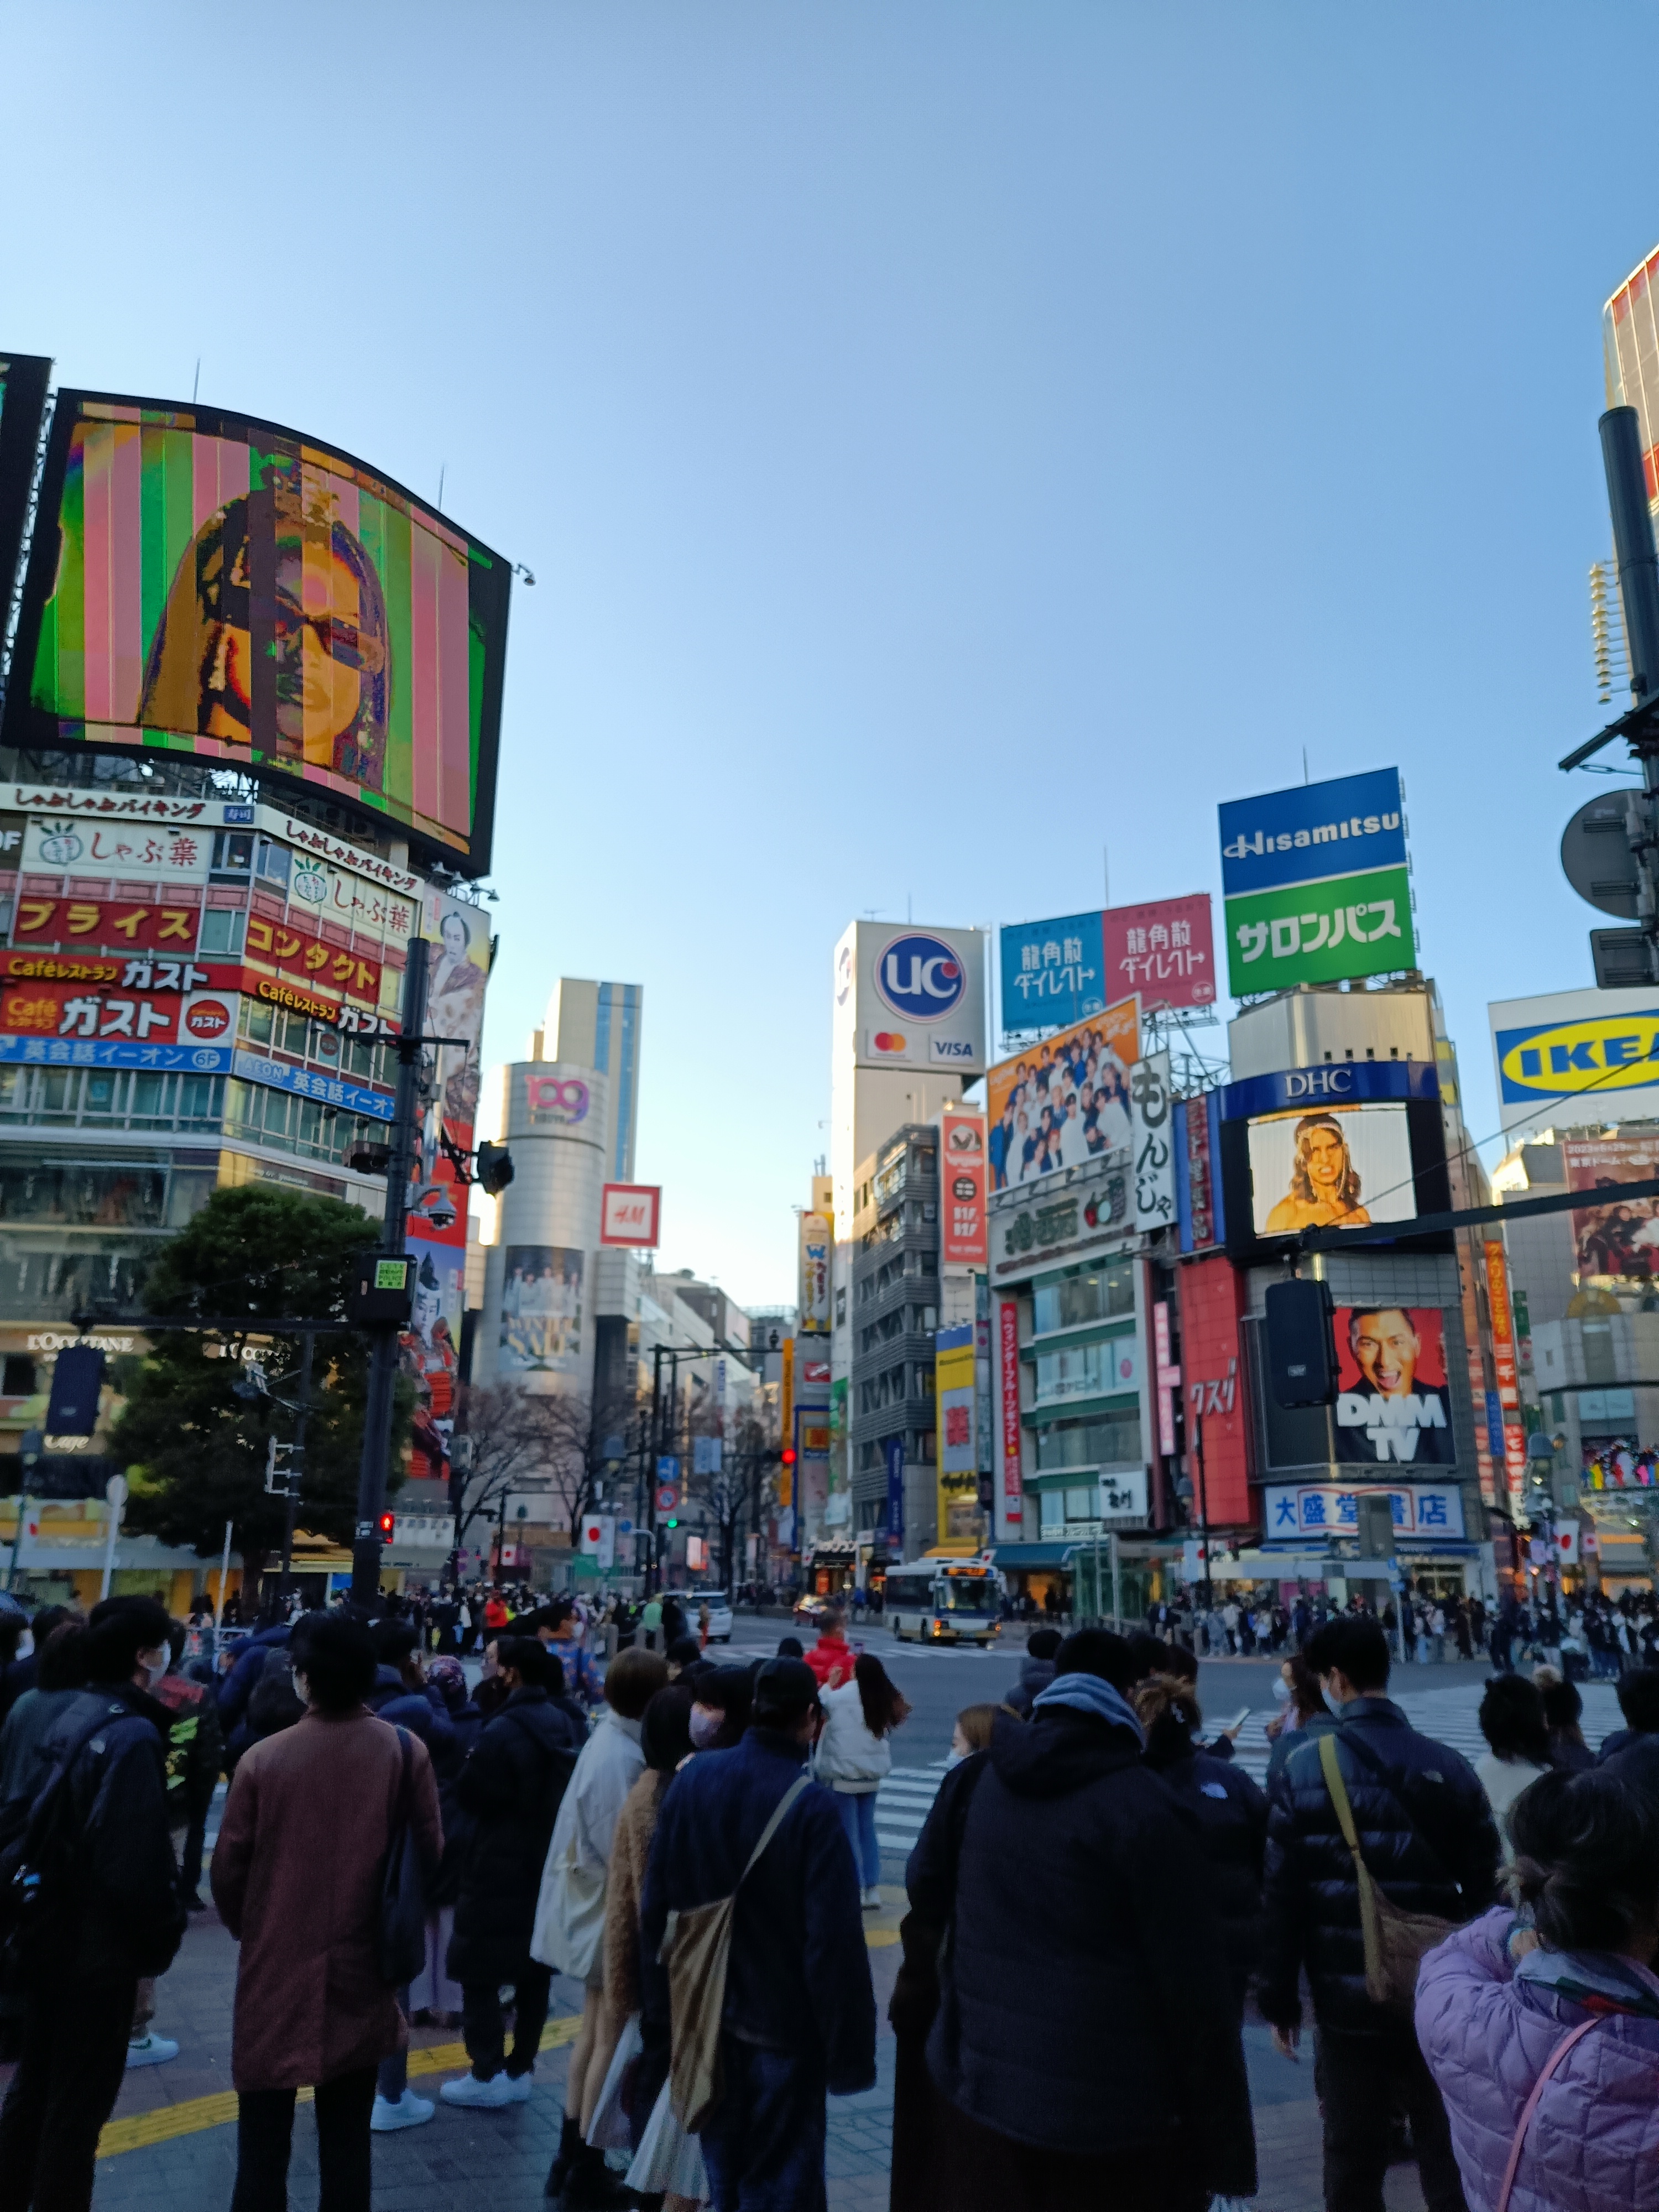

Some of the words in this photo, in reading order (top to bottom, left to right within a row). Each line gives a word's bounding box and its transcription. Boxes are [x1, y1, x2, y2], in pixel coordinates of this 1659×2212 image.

[15, 788, 206, 818] しゃぶしゃぶバイキング
[91, 832, 198, 867] しゃぶ葉
[1223, 811, 1400, 859] Hisamitsu
[286, 820, 418, 891] しゃぶしゃぶバイキング
[19, 901, 192, 940] プライス
[335, 879, 410, 933] しゃぶ葉
[1126, 920, 1191, 955] 龍角散
[1237, 899, 1401, 963] サロンパス
[247, 919, 377, 990] コンタクト
[1021, 937, 1083, 972] 龍角散
[1118, 944, 1206, 984] ダイレクト
[122, 958, 209, 991] ガスト
[1013, 961, 1095, 999] ダイレクト
[59, 995, 170, 1039] ガスト
[190, 1016, 227, 1029] ガスト
[24, 1040, 185, 1066] 英会話イーオン
[195, 1051, 219, 1066] 6F
[934, 1042, 973, 1057] VISA
[524, 1074, 589, 1124] 109
[1284, 1069, 1352, 1099] DHC
[1131, 1061, 1172, 1220] もんじゃ
[1189, 1357, 1237, 1415] クスリ
[1337, 1394, 1448, 1428] DMM
[1367, 1426, 1421, 1462] TV
[1275, 1494, 1448, 1526] 大盛堂書店
